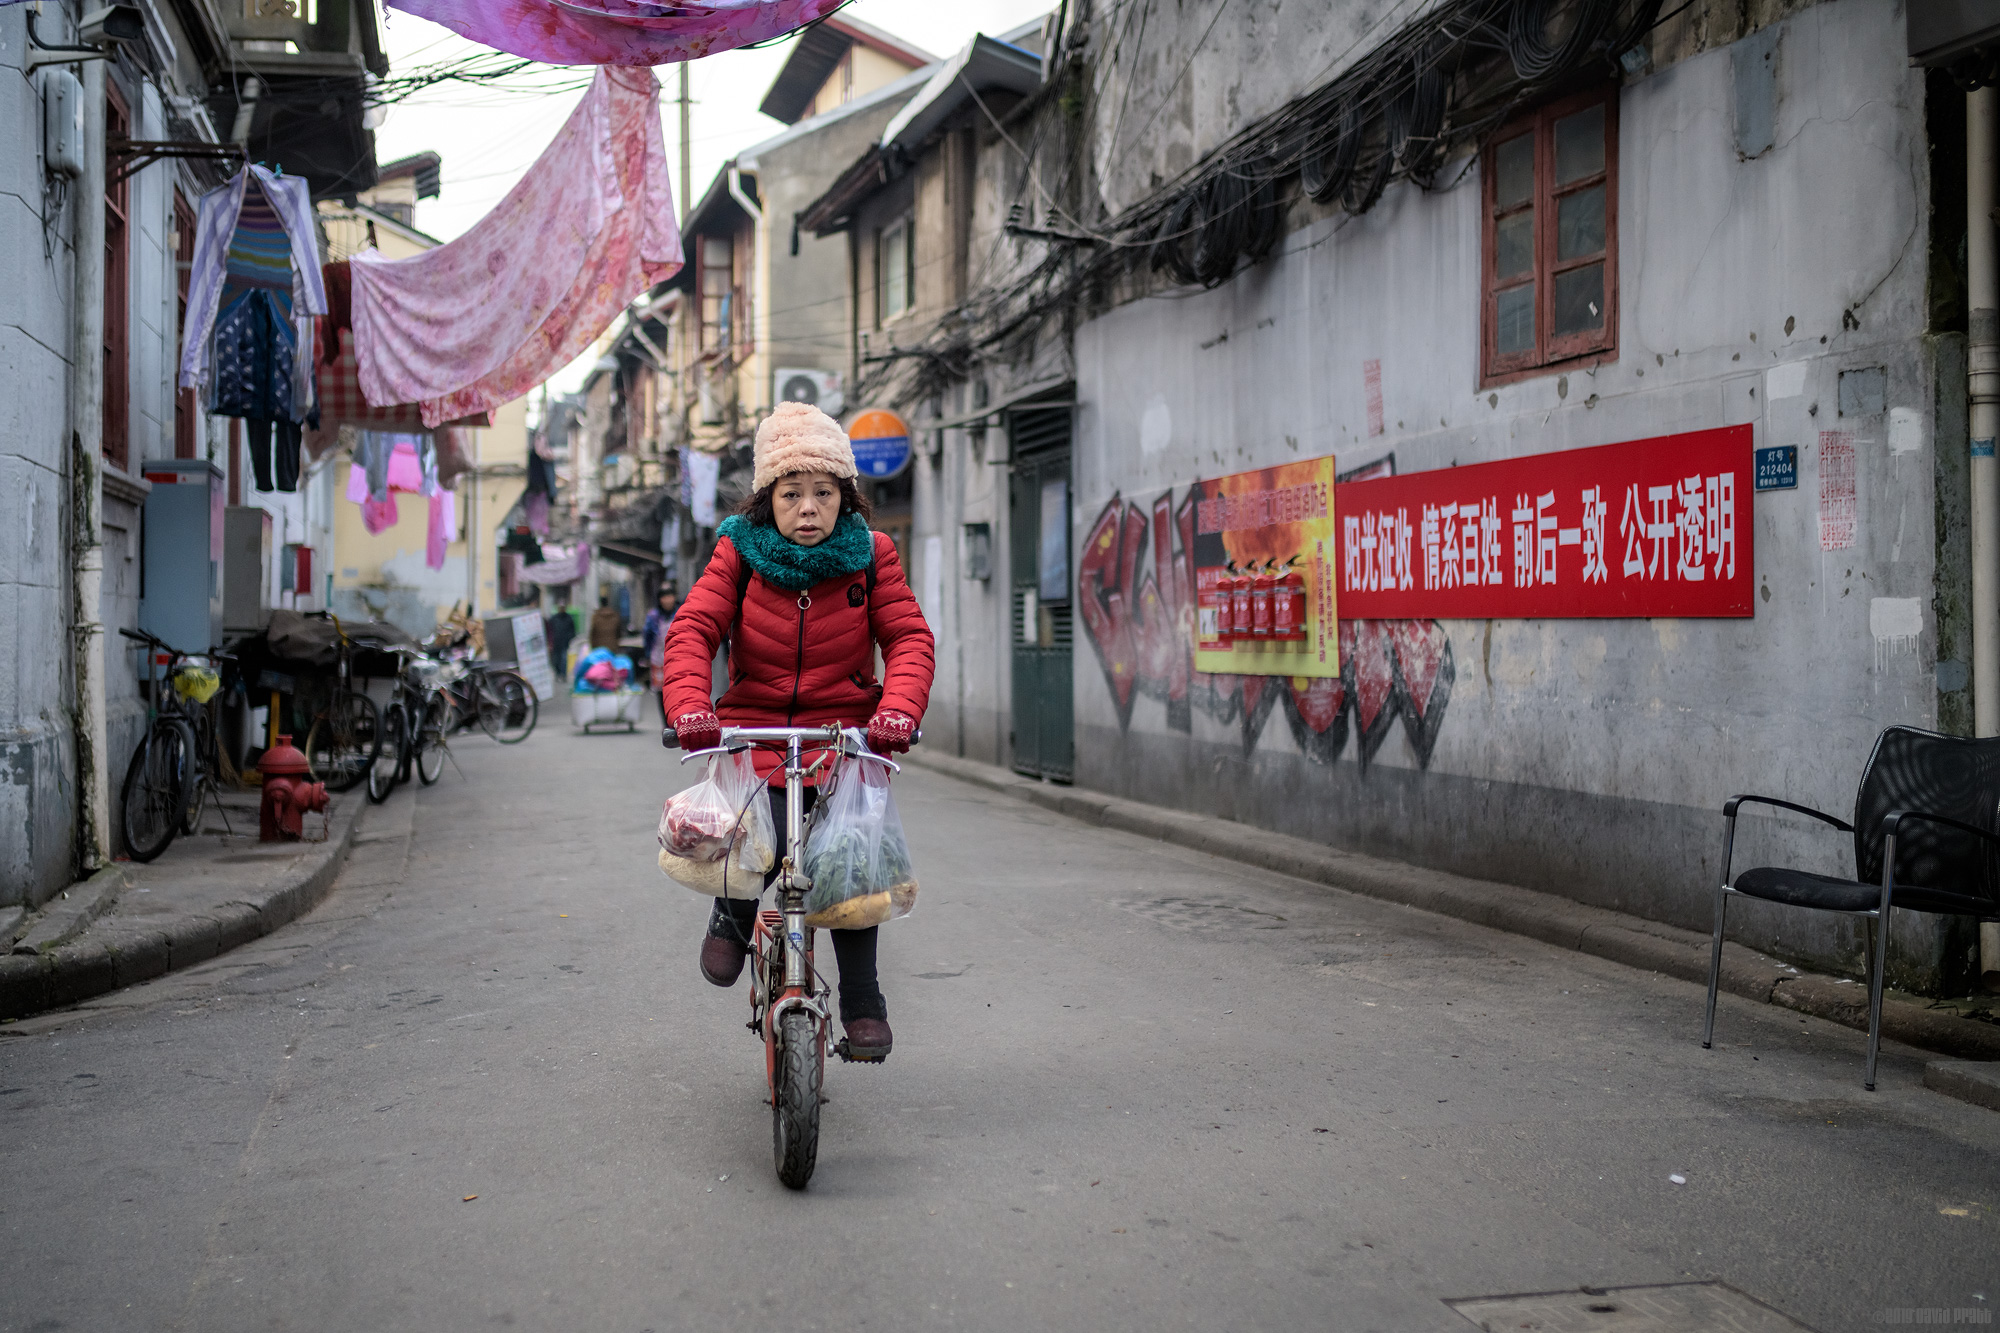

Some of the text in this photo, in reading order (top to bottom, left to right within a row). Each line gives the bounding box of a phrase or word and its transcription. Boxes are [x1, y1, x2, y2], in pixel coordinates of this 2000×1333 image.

[1767, 449, 1784, 462] 灯号
[1760, 463, 1793, 477] 212404
[1343, 509, 1414, 593] 阳光征收
[1420, 495, 1503, 592] 情系百姓
[1511, 483, 1608, 589] 前后一致
[1619, 471, 1735, 582] 公开透明
